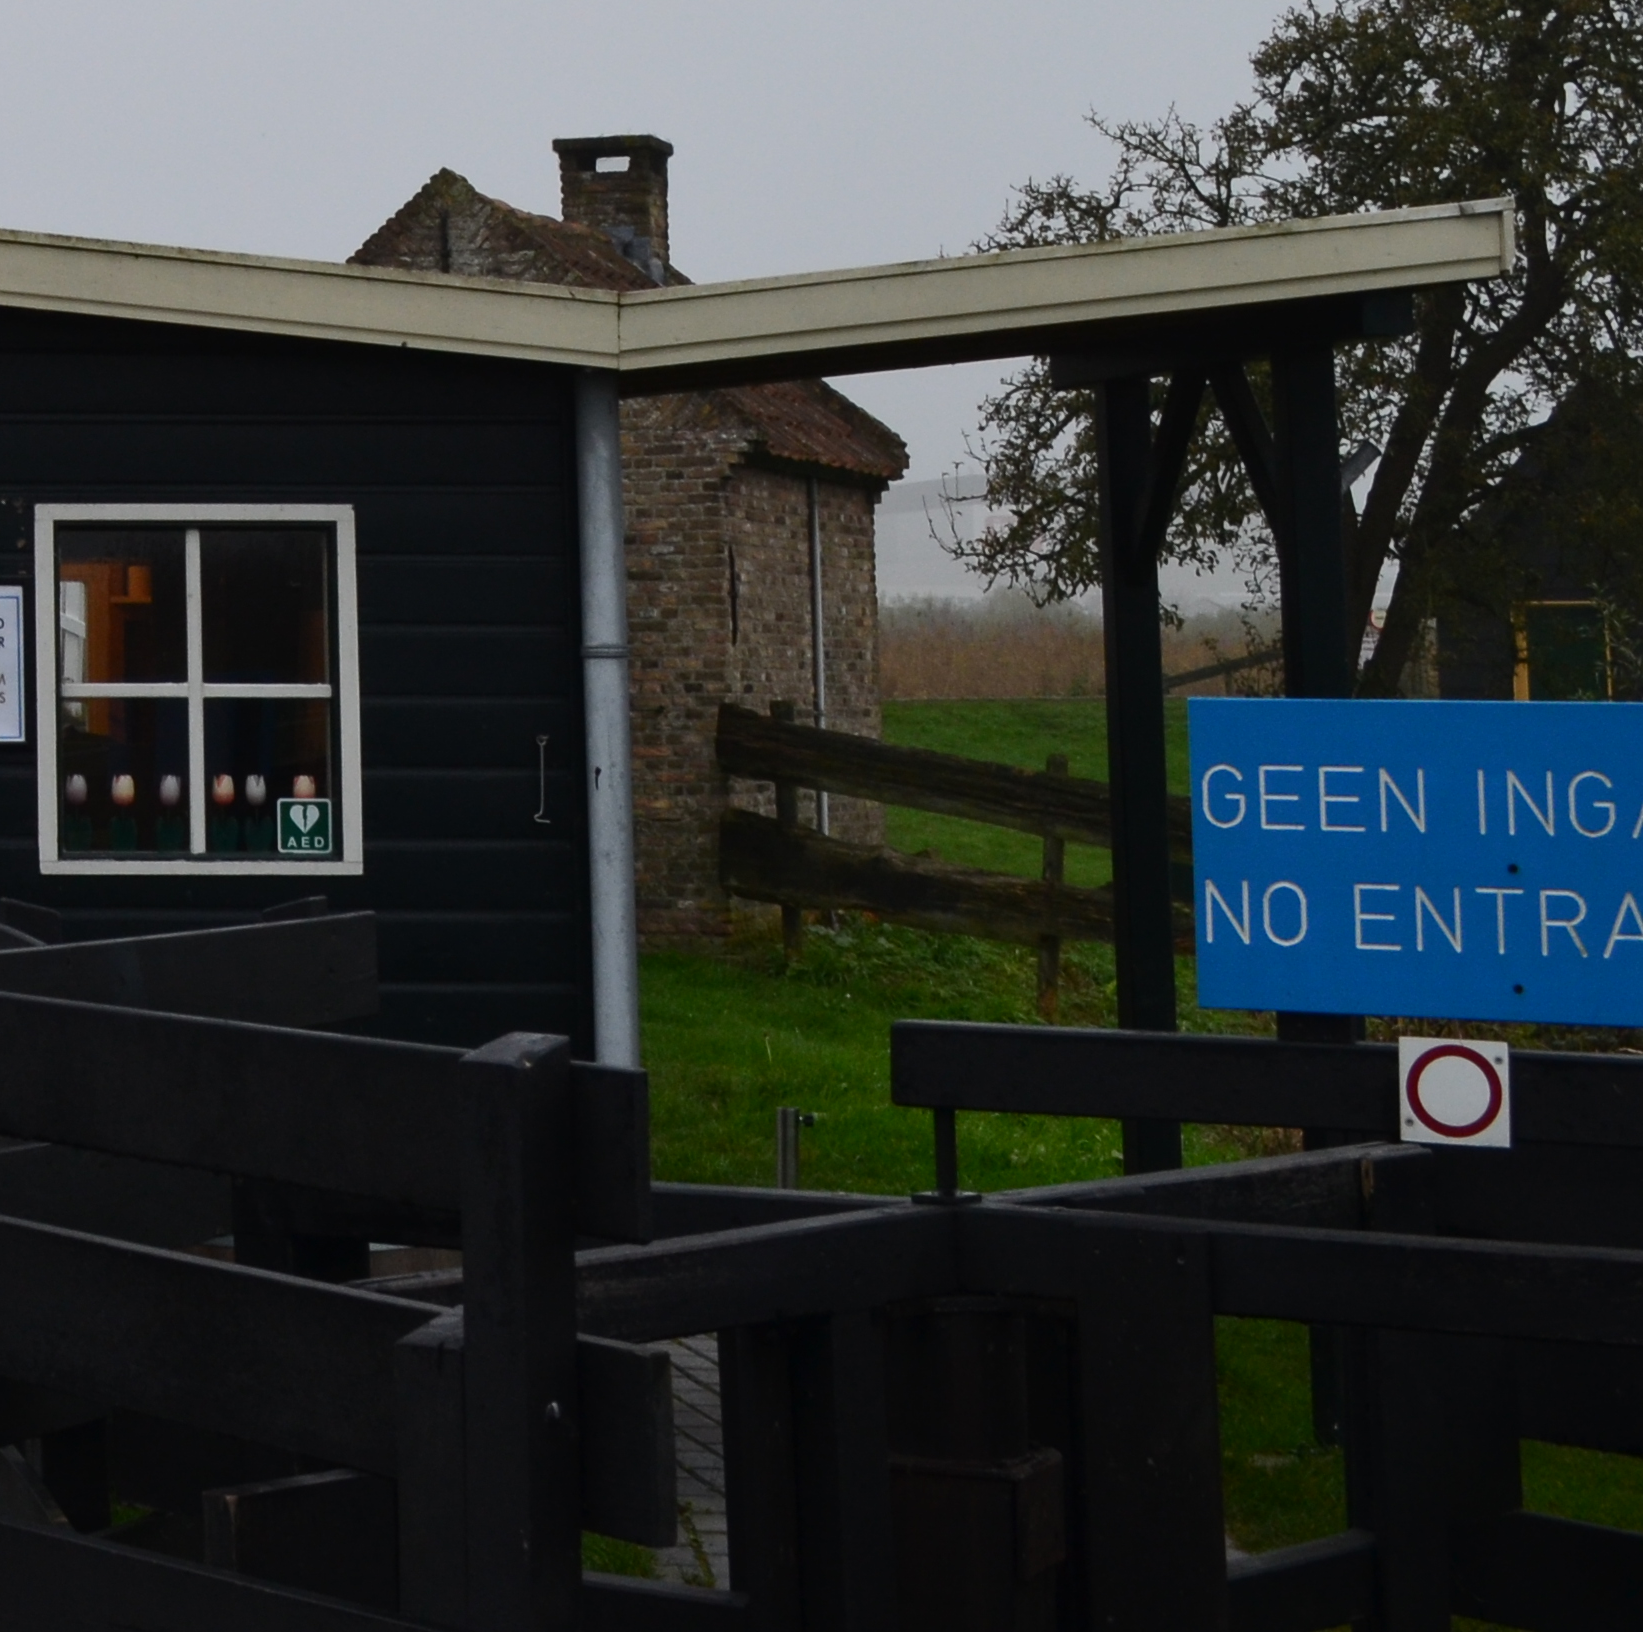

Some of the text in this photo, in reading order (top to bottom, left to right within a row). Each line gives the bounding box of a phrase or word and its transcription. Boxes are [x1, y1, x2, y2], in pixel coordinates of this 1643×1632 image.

[1201, 764, 1643, 839] GEEN ING
[287, 836, 325, 848] AED
[1205, 879, 1308, 947] NO
